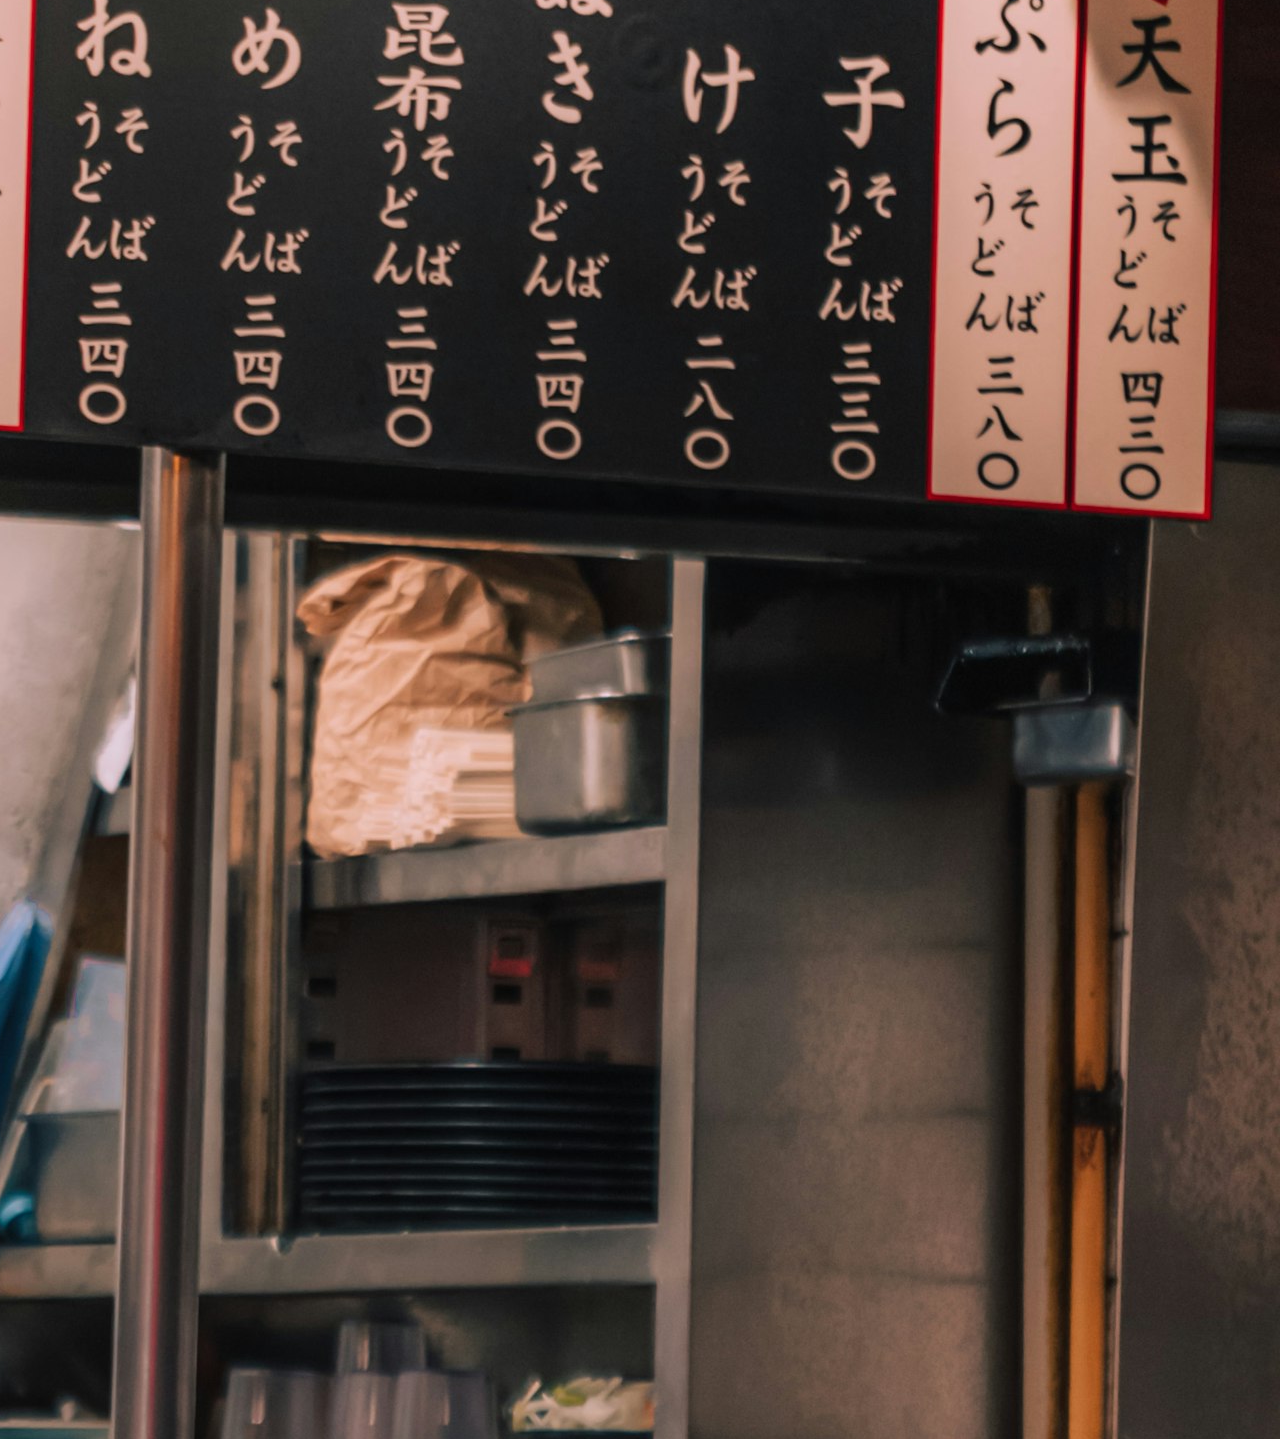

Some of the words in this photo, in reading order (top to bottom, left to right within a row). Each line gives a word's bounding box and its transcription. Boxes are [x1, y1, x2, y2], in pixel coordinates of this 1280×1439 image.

[1111, 14, 1192, 186] 天玉
[78, 281, 133, 426] 三四〇
[231, 293, 286, 437] 三四〇
[384, 304, 438, 449] 三四〇
[534, 317, 589, 461] 三四〇
[682, 333, 735, 471] 二八〇
[828, 341, 882, 482] 三三〇
[976, 355, 1025, 491] 三八〇
[1118, 371, 1165, 500] 四三〇
